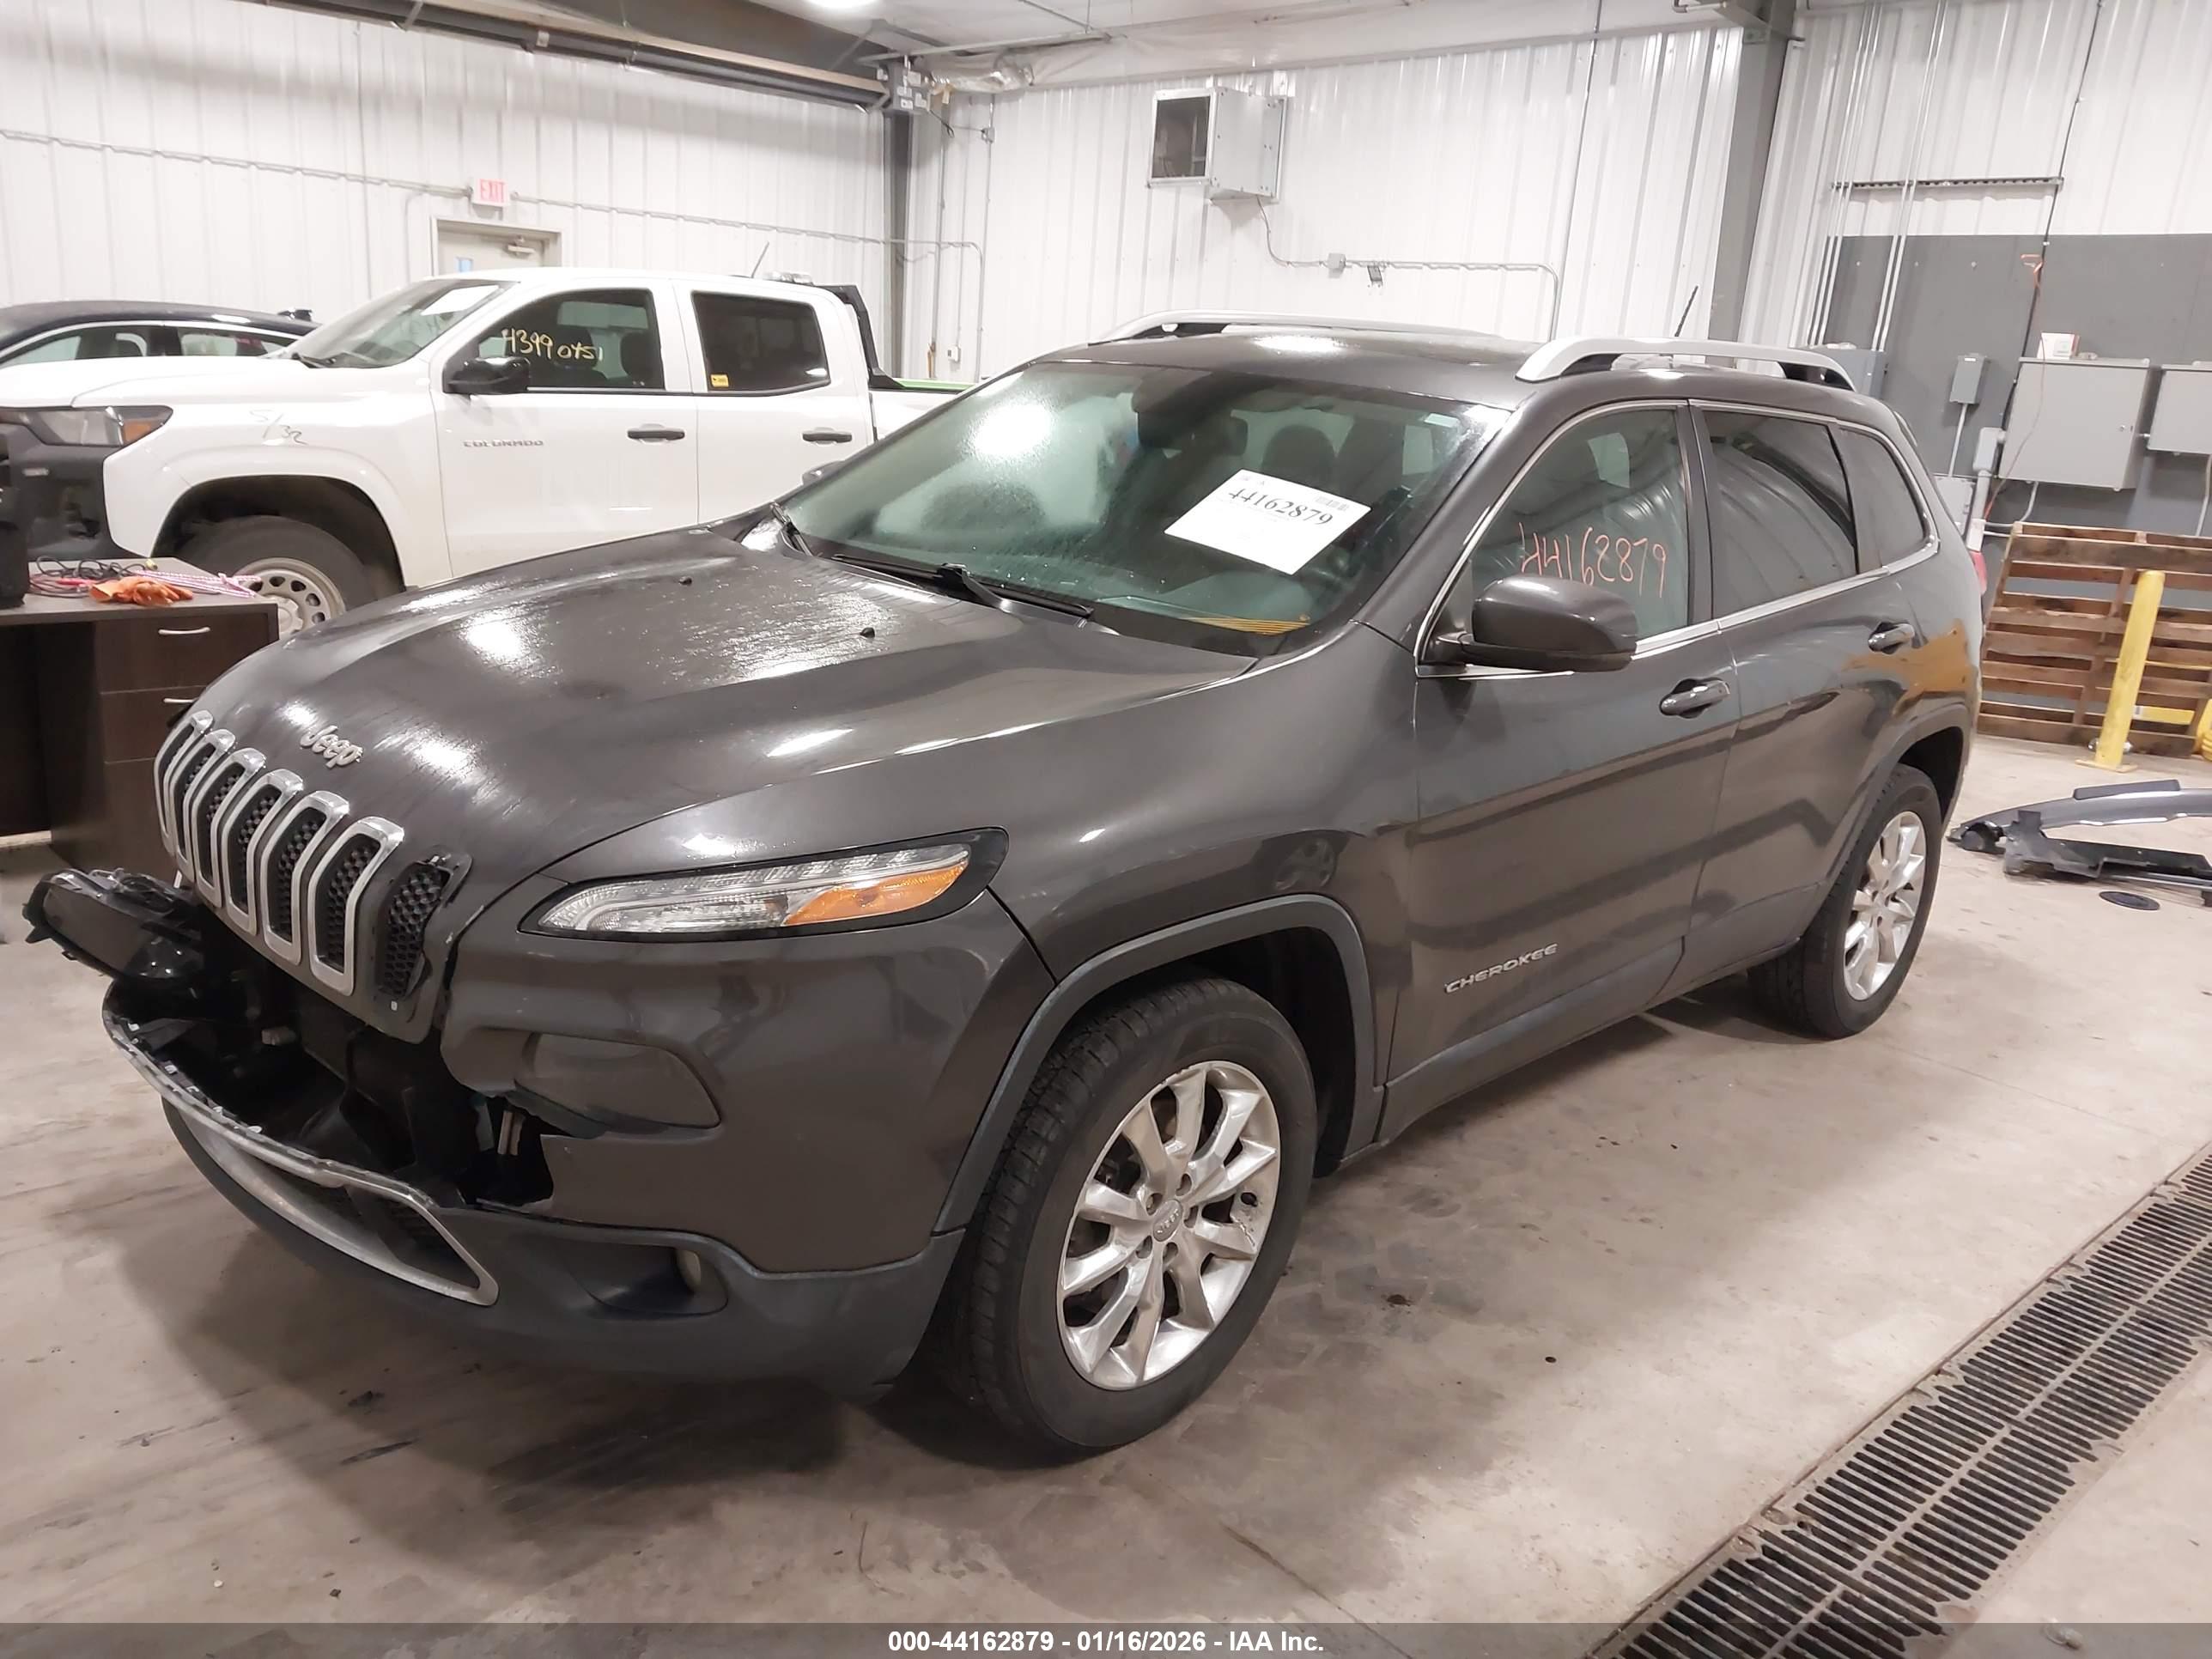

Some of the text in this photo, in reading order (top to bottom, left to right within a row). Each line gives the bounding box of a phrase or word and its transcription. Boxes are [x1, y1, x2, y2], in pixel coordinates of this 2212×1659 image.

[480, 179, 504, 203] EXIT
[1228, 488, 1334, 526] 44162879
[1519, 522, 1667, 598] 44162879
[300, 725, 363, 769] Jeep
[1446, 943, 1558, 994] CHEROKEE
